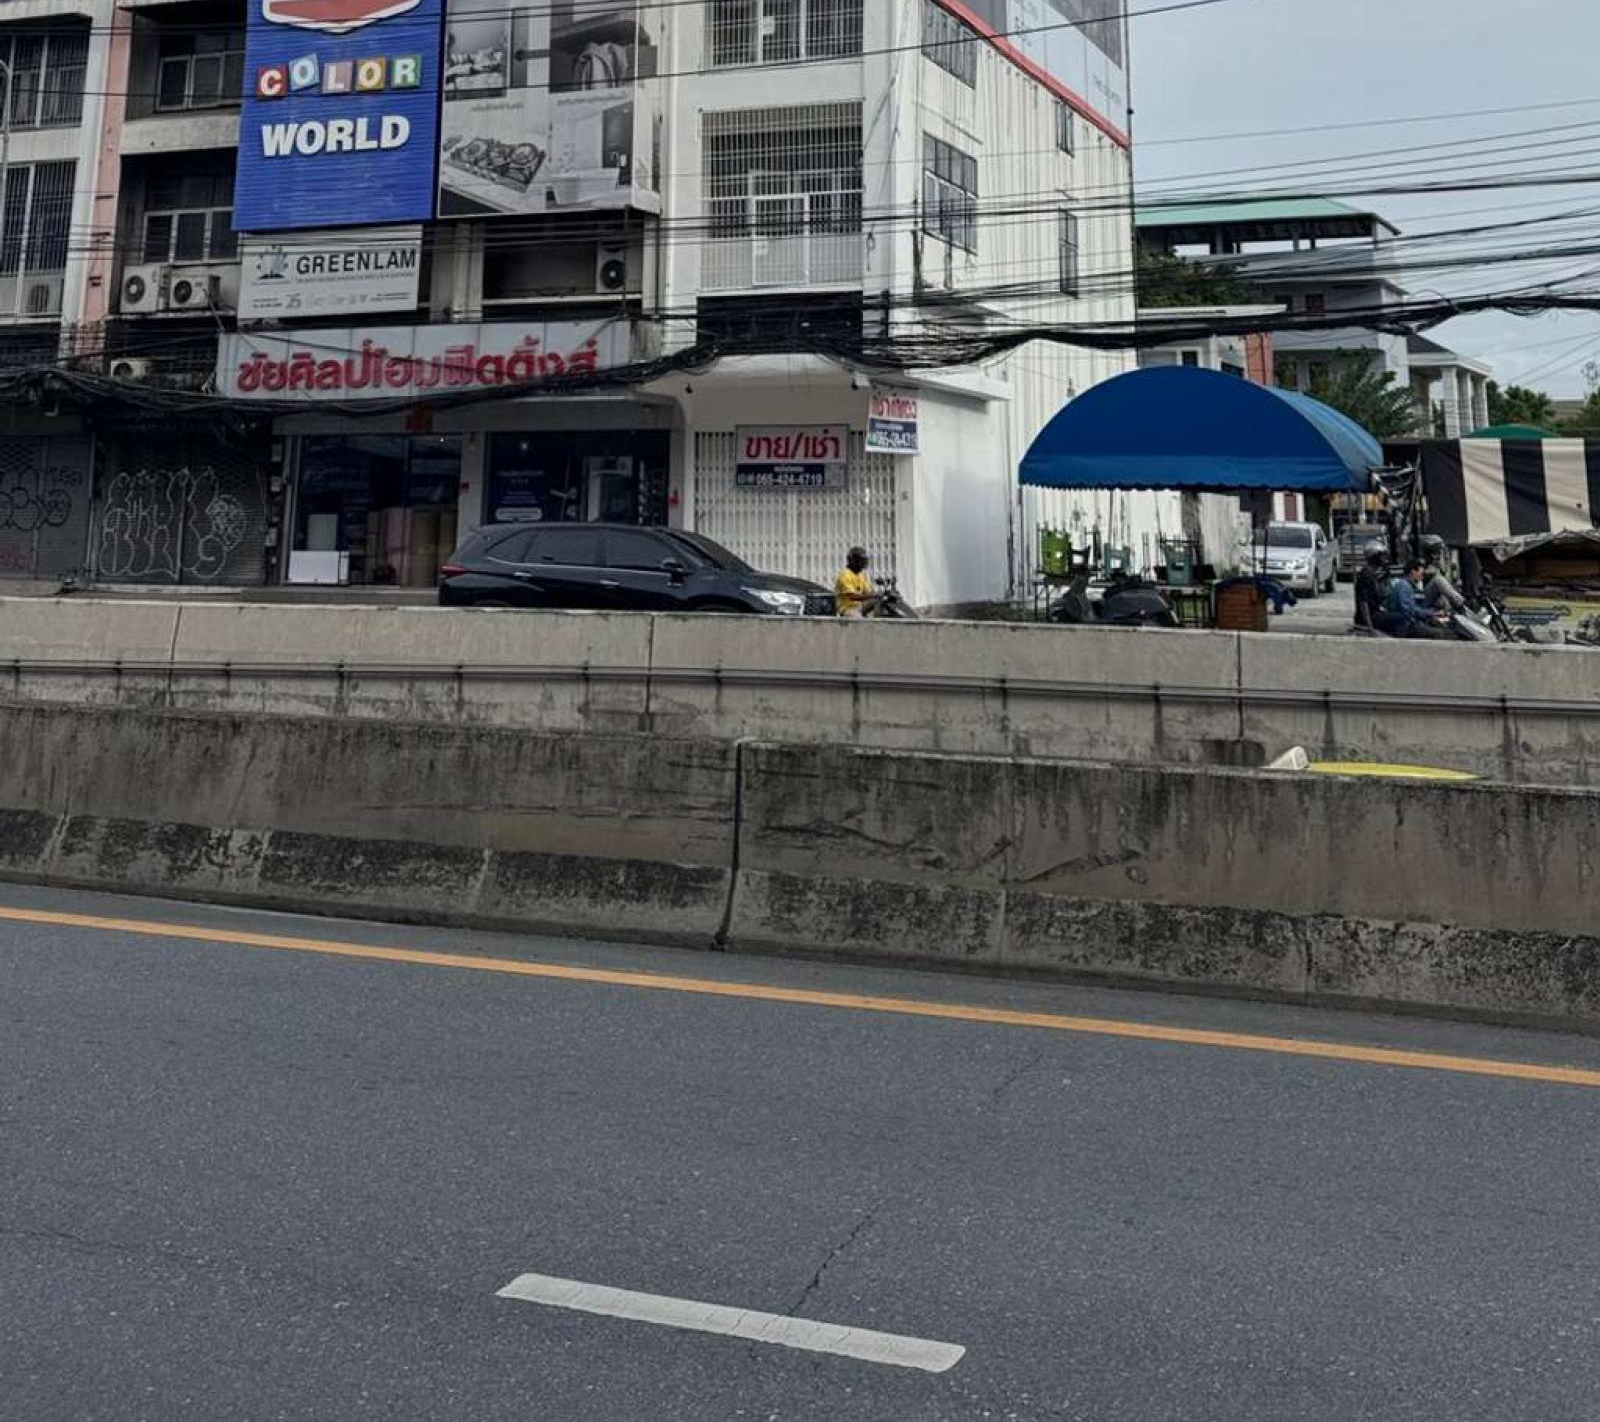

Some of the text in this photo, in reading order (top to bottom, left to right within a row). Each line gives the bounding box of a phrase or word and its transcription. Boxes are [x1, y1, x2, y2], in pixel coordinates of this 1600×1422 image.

[258, 55, 420, 97] COLOR
[261, 114, 411, 158] WORLD
[296, 247, 418, 275] GREENLAM
[745, 428, 840, 460] ขาย/เช่า
